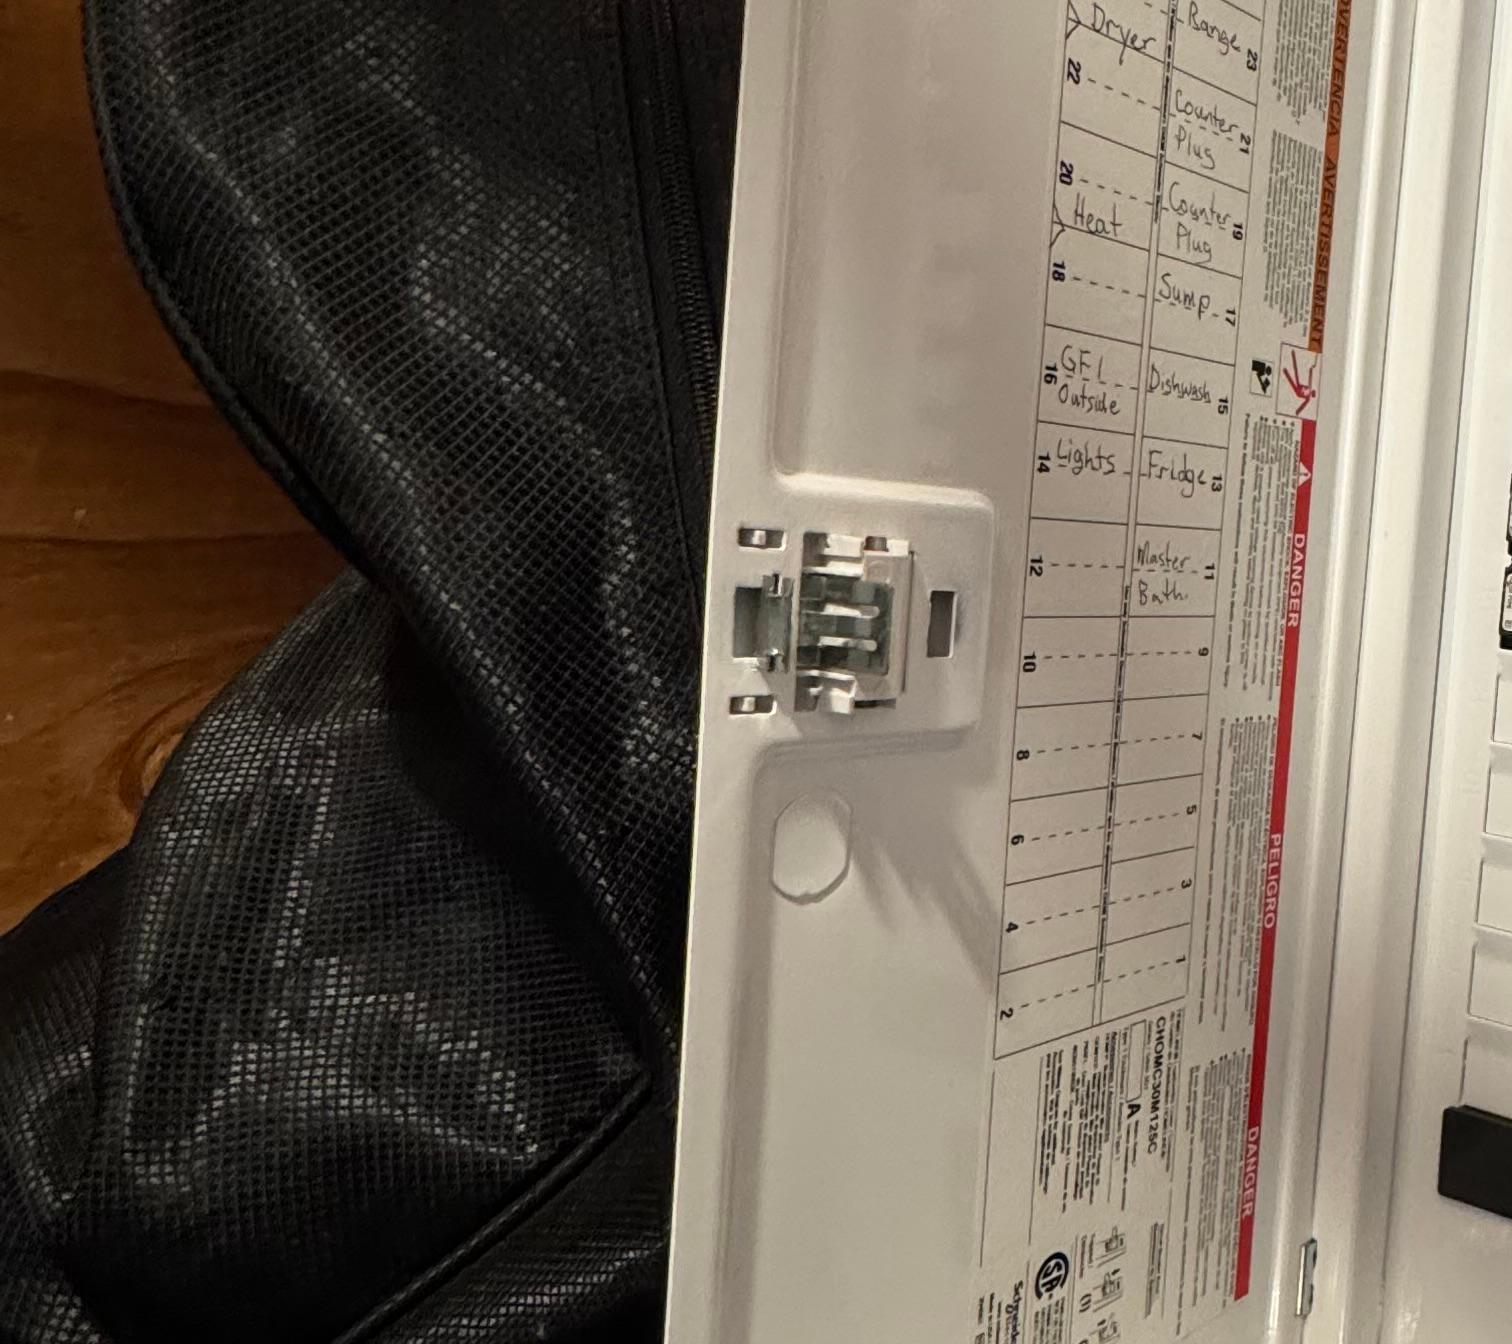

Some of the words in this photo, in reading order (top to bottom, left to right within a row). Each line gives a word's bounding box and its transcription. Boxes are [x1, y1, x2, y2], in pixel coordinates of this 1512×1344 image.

[1093, 2, 1157, 66] Dryer
[1189, 0, 1241, 56] Range
[1067, 58, 1081, 85] 22
[1247, 49, 1258, 72] 23
[1176, 90, 1238, 133] Counter
[1175, 125, 1215, 170] Plug
[1240, 133, 1251, 155] 21
[1059, 160, 1074, 186] 20
[1074, 192, 1122, 237] Heat
[1169, 181, 1232, 225] Counter
[1177, 222, 1212, 266] Plug
[1232, 223, 1243, 241] 19
[1309, 157, 1338, 351] AVERTISSEMENT
[1052, 261, 1066, 282] 18
[1159, 273, 1210, 320] Sump
[1225, 307, 1236, 327] 17
[1044, 365, 1058, 385] 16
[1150, 363, 1211, 403] Dishwash
[1058, 384, 1120, 415] Outside
[1218, 398, 1228, 415] 15
[1037, 454, 1050, 473] 14
[1057, 438, 1115, 475] Lights
[1148, 450, 1207, 498] Fridge
[1212, 475, 1222, 493] 13
[1029, 556, 1043, 577] 12
[1137, 541, 1190, 567] Master
[1204, 563, 1215, 581] 11
[1288, 534, 1305, 627] DANGER
[1263, 833, 1282, 929] PELIGRO
[1241, 1126, 1260, 1218] DANGER
